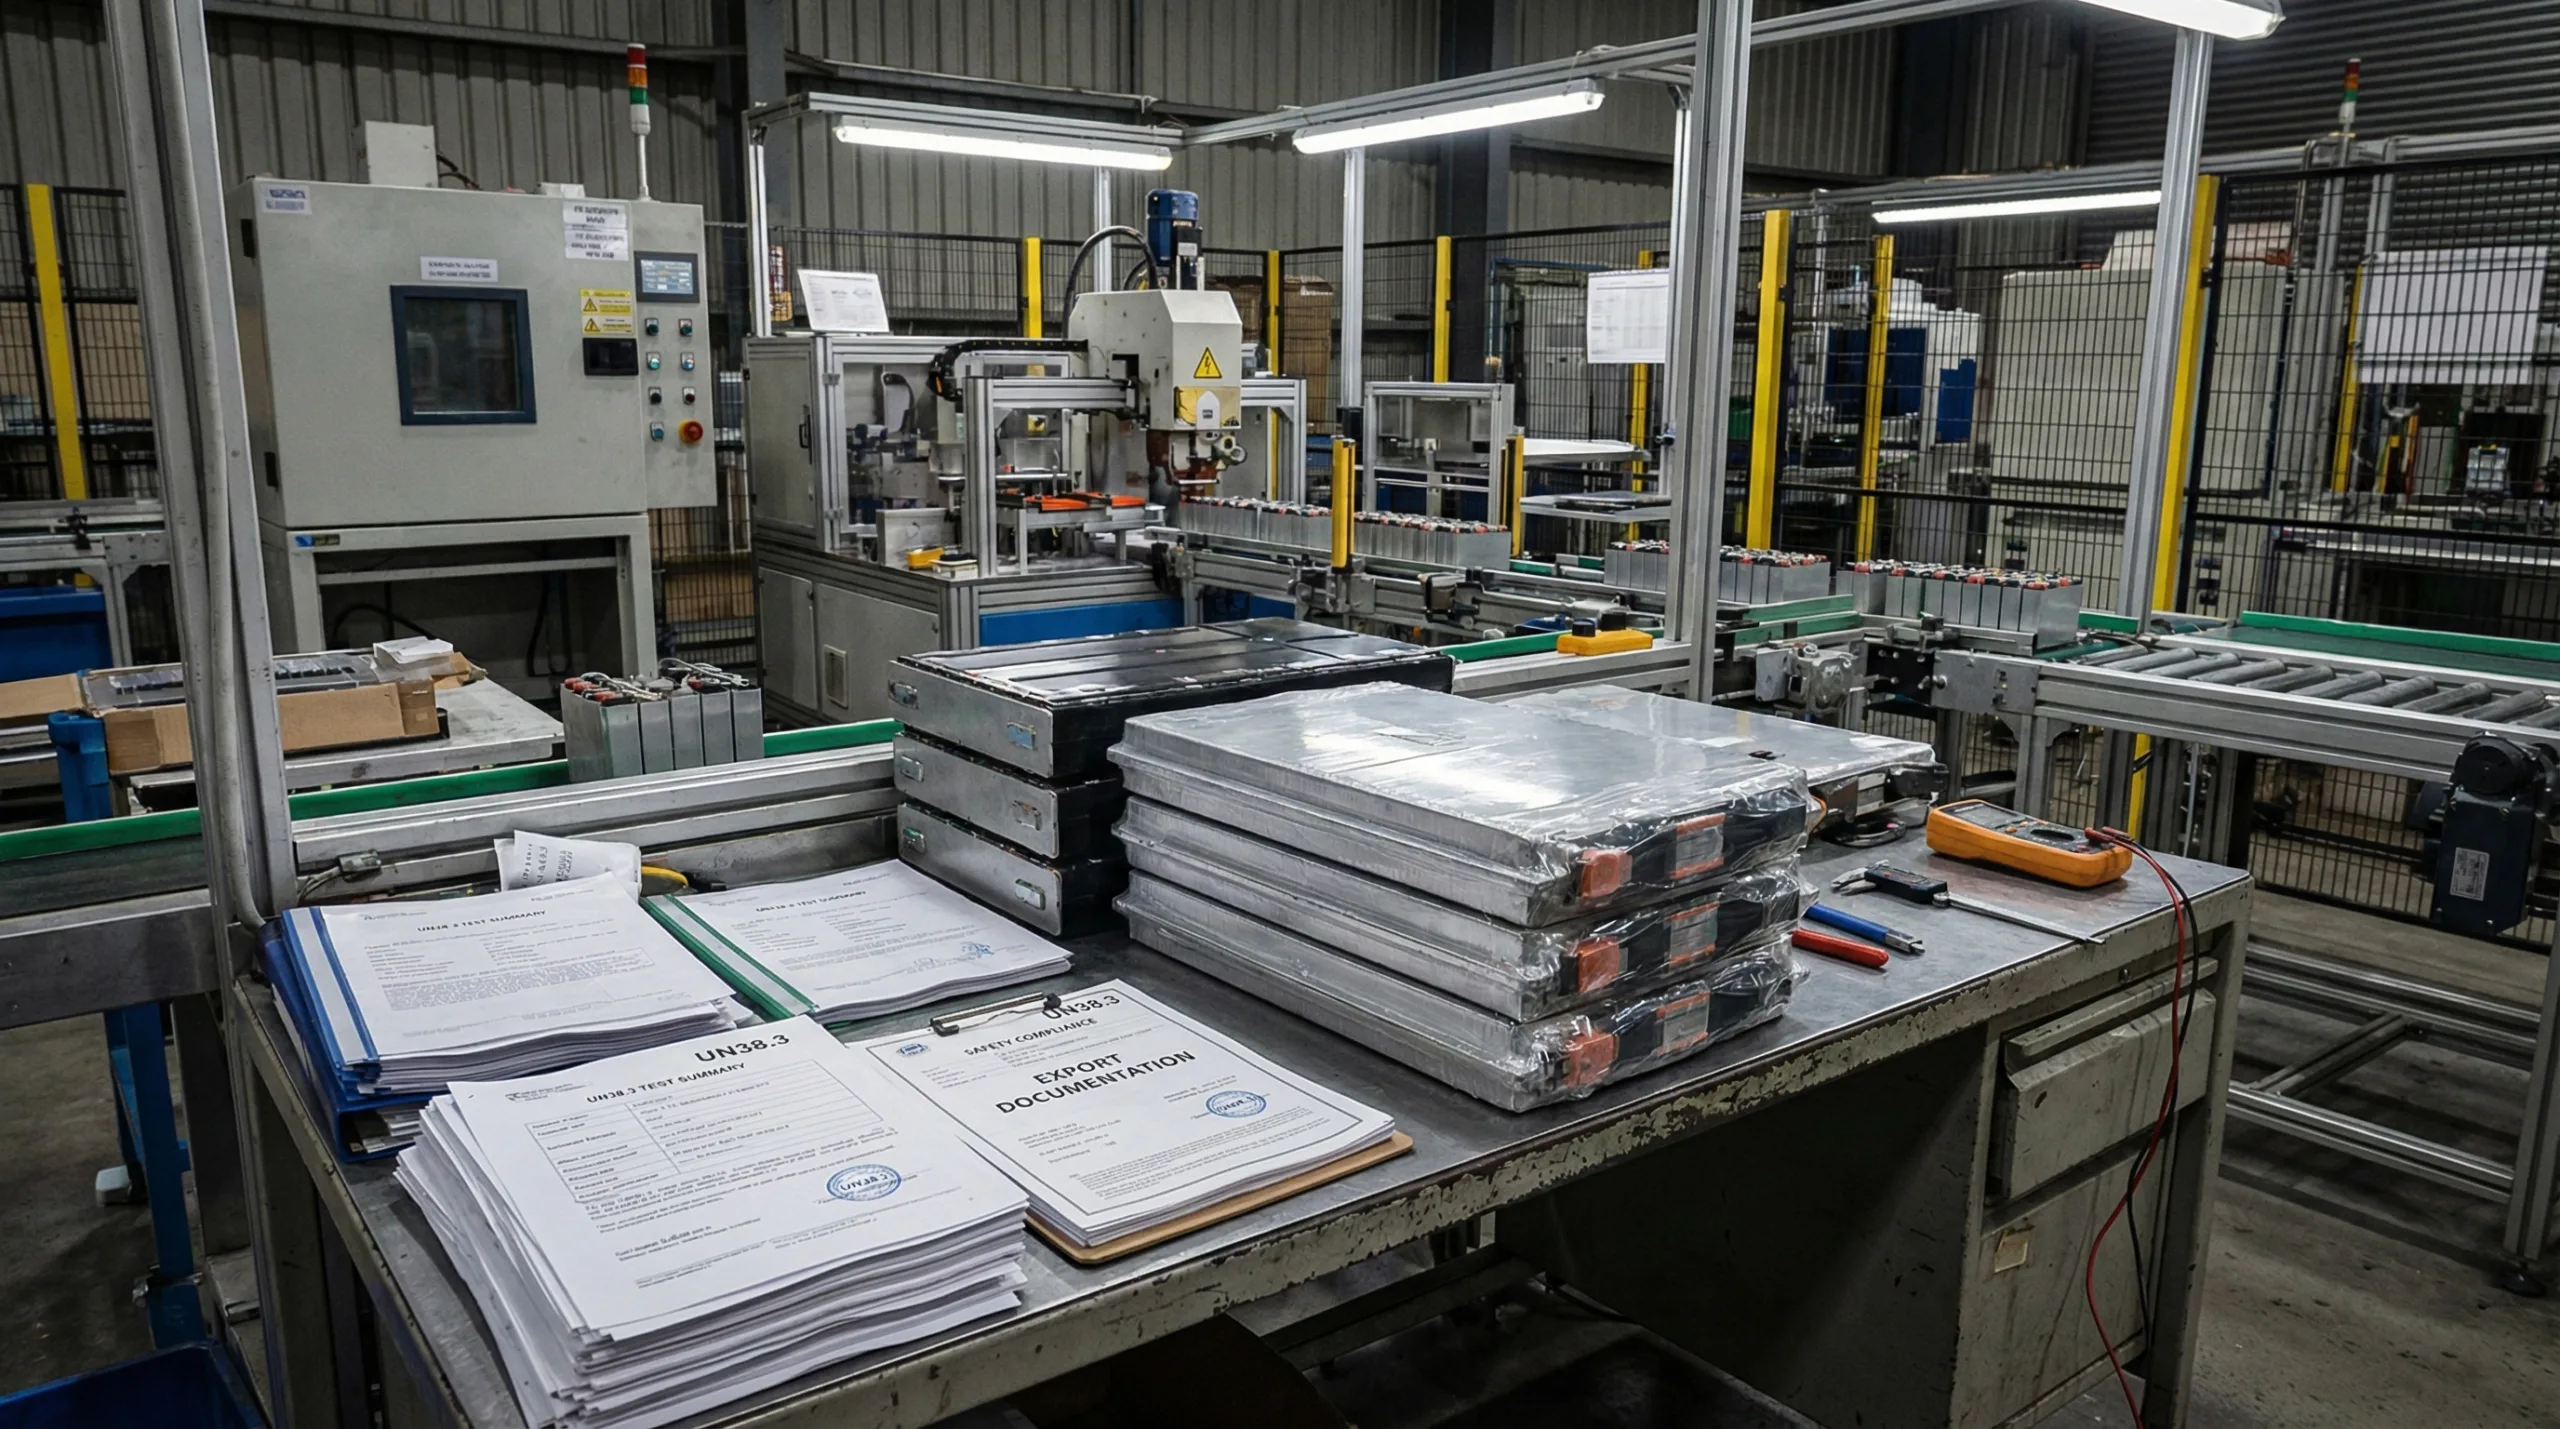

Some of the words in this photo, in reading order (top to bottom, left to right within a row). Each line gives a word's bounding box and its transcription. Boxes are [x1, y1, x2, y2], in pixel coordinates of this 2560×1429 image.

[1041, 995, 1120, 1020] UN38.3
[694, 1034, 790, 1062] UN38.3
[964, 1038, 1013, 1056] SAFETY
[1015, 1017, 1098, 1043] COMPLIANCE
[638, 1078, 674, 1092] TEST
[677, 1062, 746, 1083] SUMMARY
[994, 1050, 1196, 1114] DOCUMENTATION
[1032, 1053, 1124, 1085] EXPORT
